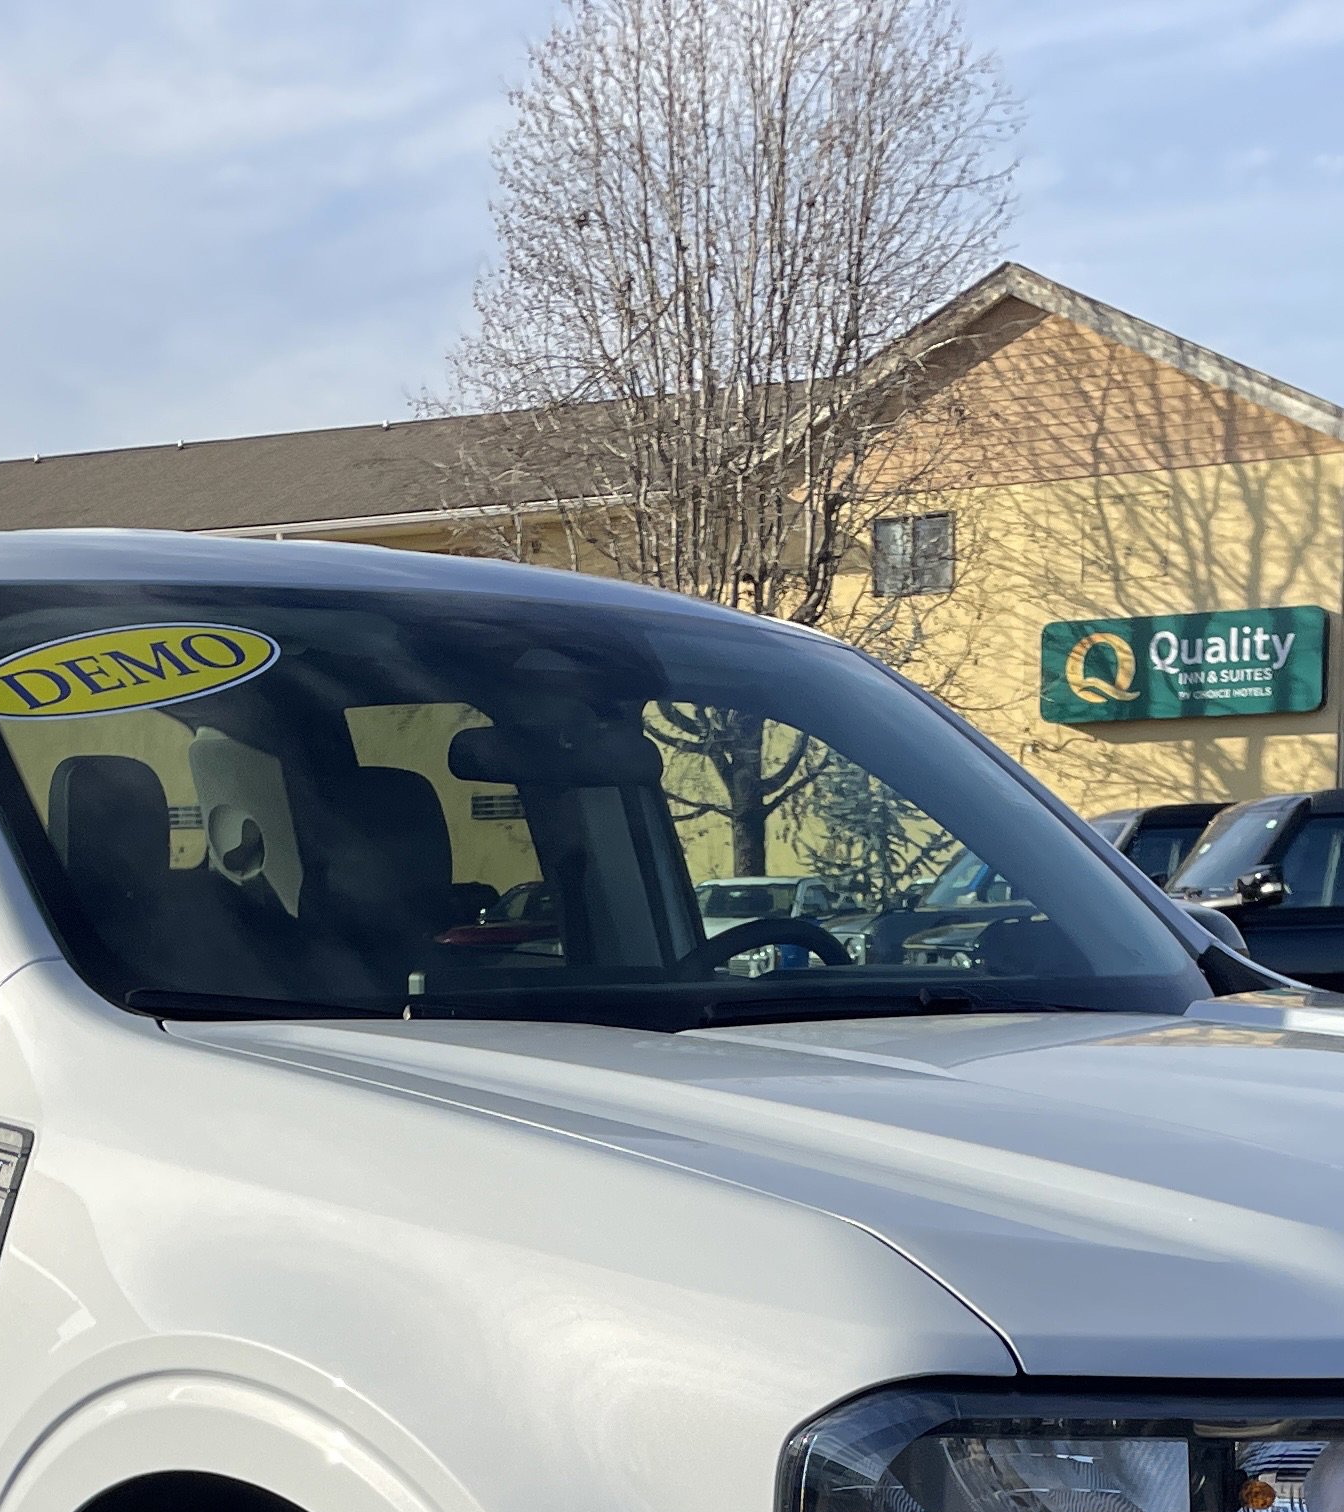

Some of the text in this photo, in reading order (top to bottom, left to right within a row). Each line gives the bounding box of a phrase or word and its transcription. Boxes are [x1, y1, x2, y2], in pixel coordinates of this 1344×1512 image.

[1149, 626, 1296, 674] Quality
[1178, 667, 1273, 685] INN & SUITES
[1193, 688, 1231, 699] CHOICE
[1232, 687, 1273, 698] HOTELS
